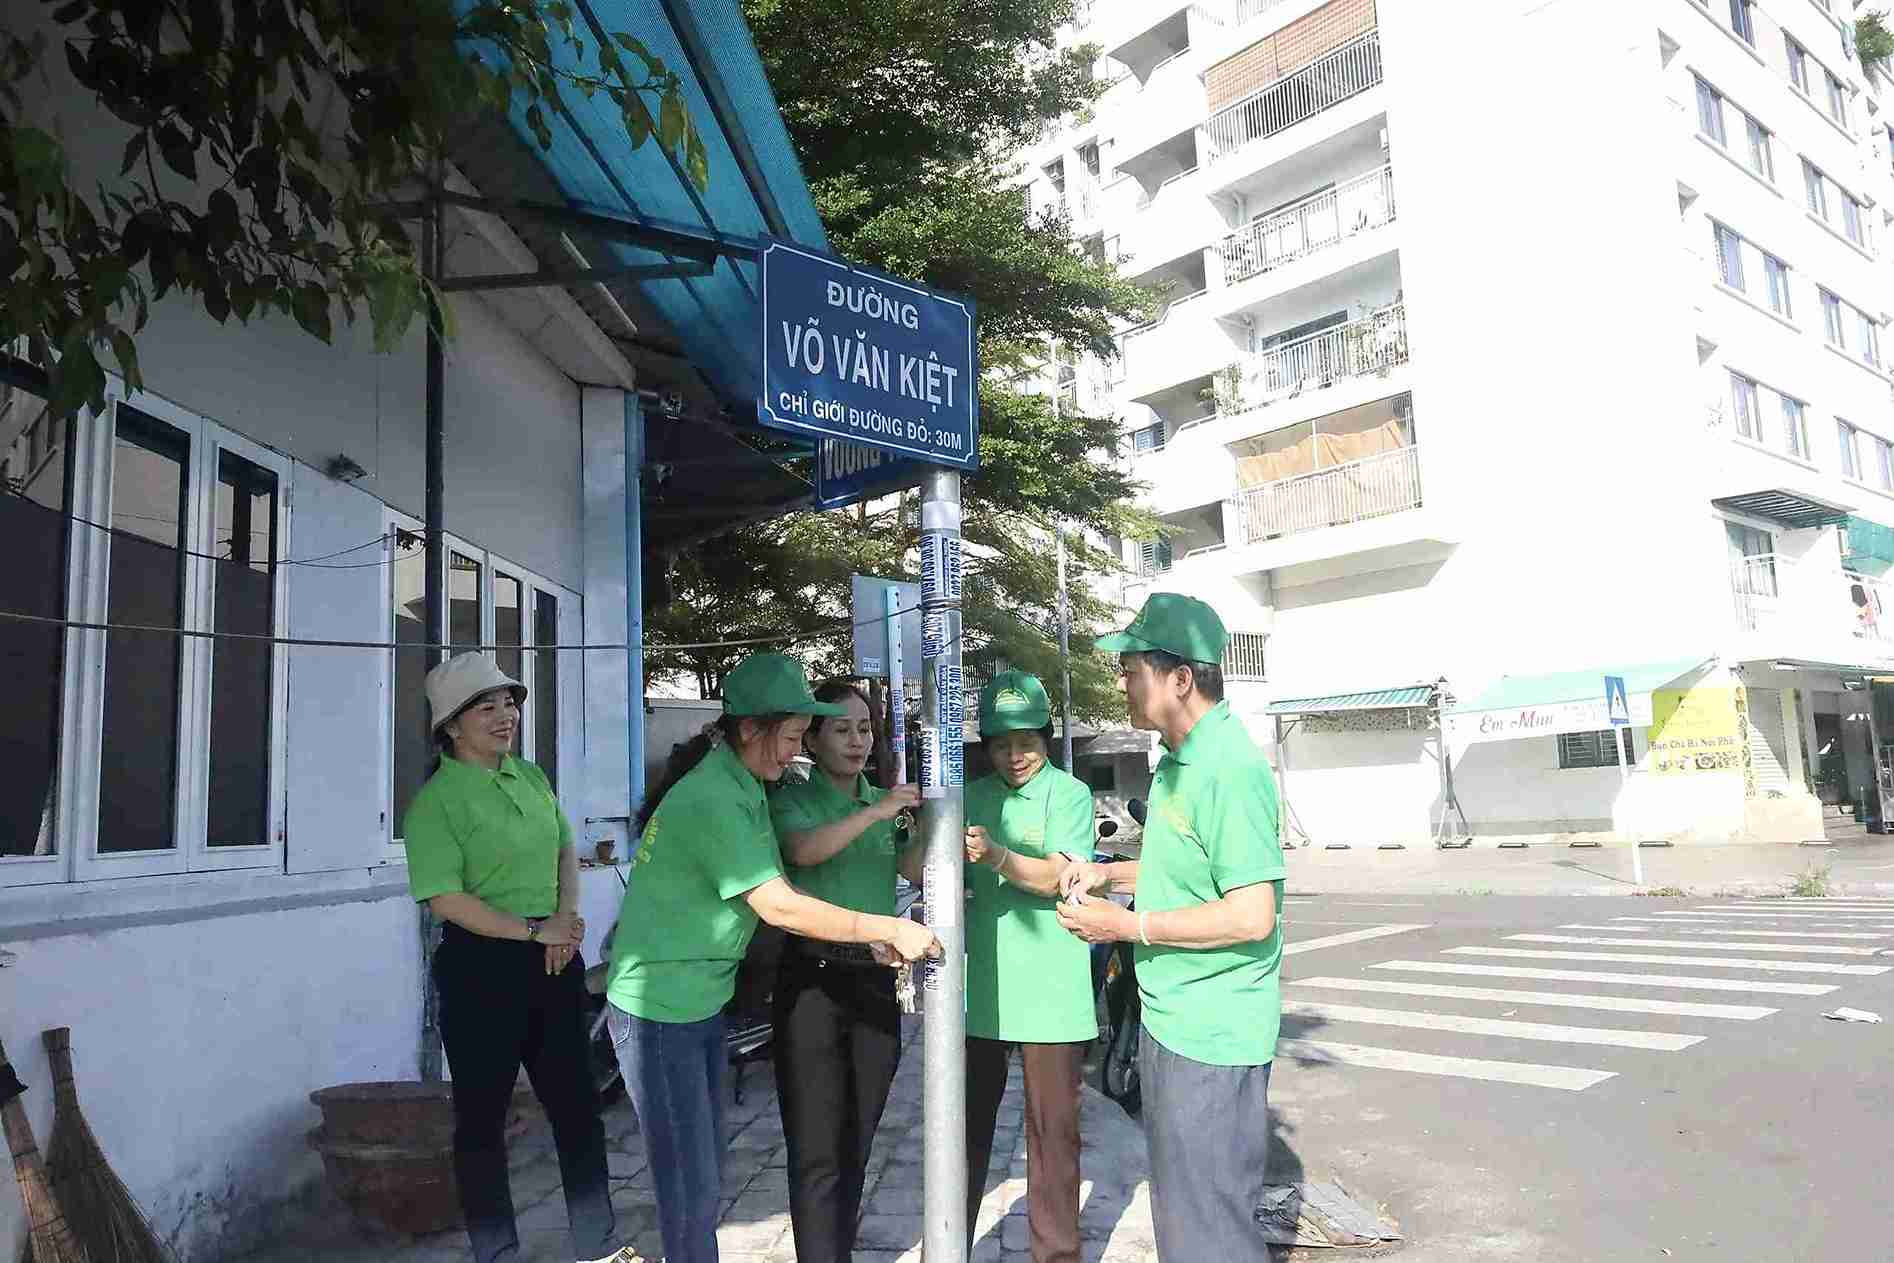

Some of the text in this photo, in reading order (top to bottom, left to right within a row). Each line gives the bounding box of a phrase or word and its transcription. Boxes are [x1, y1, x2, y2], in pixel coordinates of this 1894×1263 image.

[827, 280, 919, 330] ĐƯỜNG
[782, 317, 958, 413] VÕ VĂN KIỆT
[780, 390, 808, 415] CHỈ
[812, 399, 845, 423] GIỚI
[849, 408, 903, 437] ĐƯỜNG
[936, 430, 962, 450] 30M
